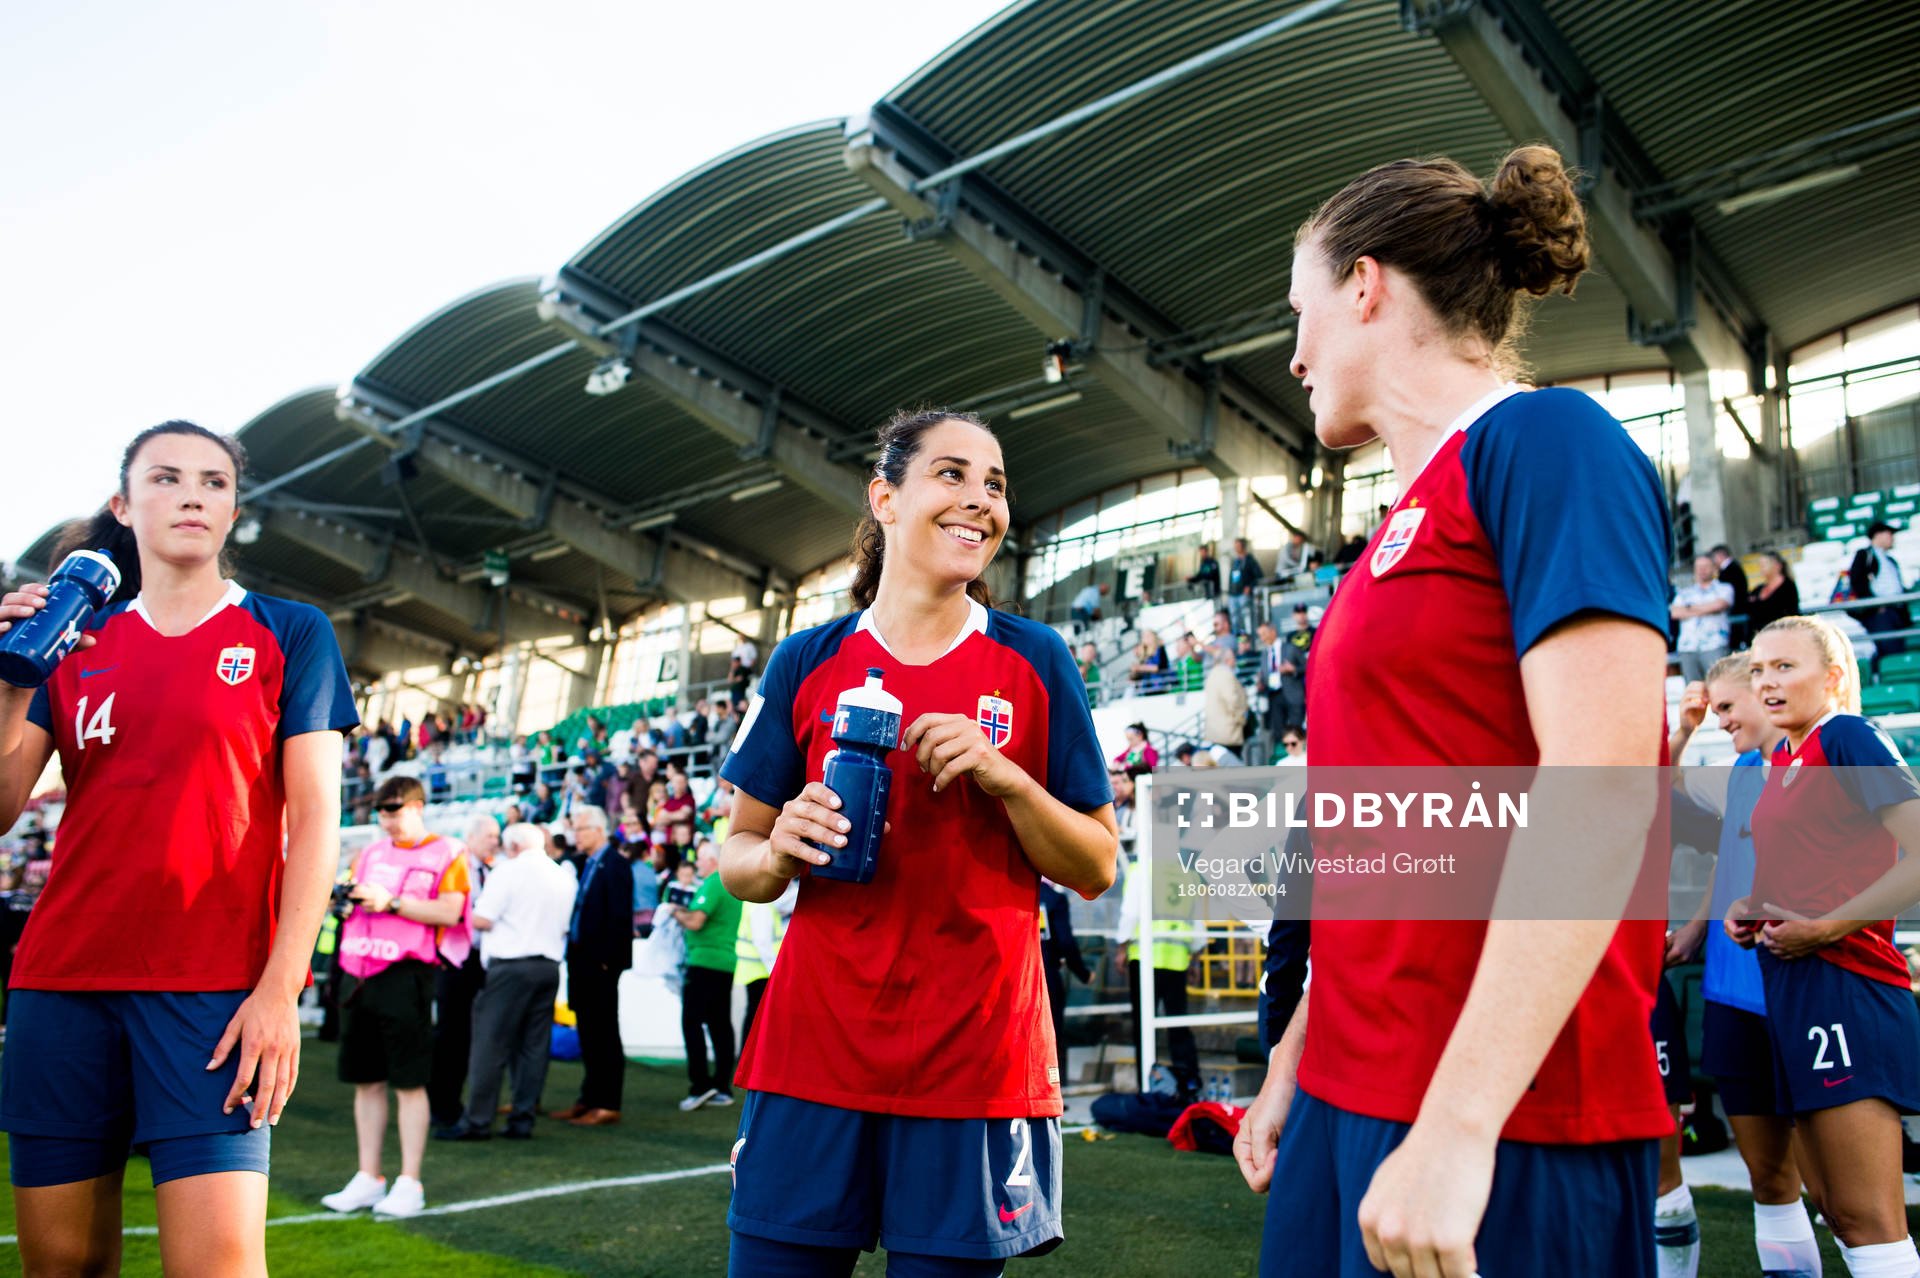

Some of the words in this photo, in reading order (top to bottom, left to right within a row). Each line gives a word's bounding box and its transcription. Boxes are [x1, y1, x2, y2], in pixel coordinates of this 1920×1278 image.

[75, 691, 117, 750] 14
[1808, 1023, 1852, 1070] 21
[1005, 1117, 1031, 1186] 2
